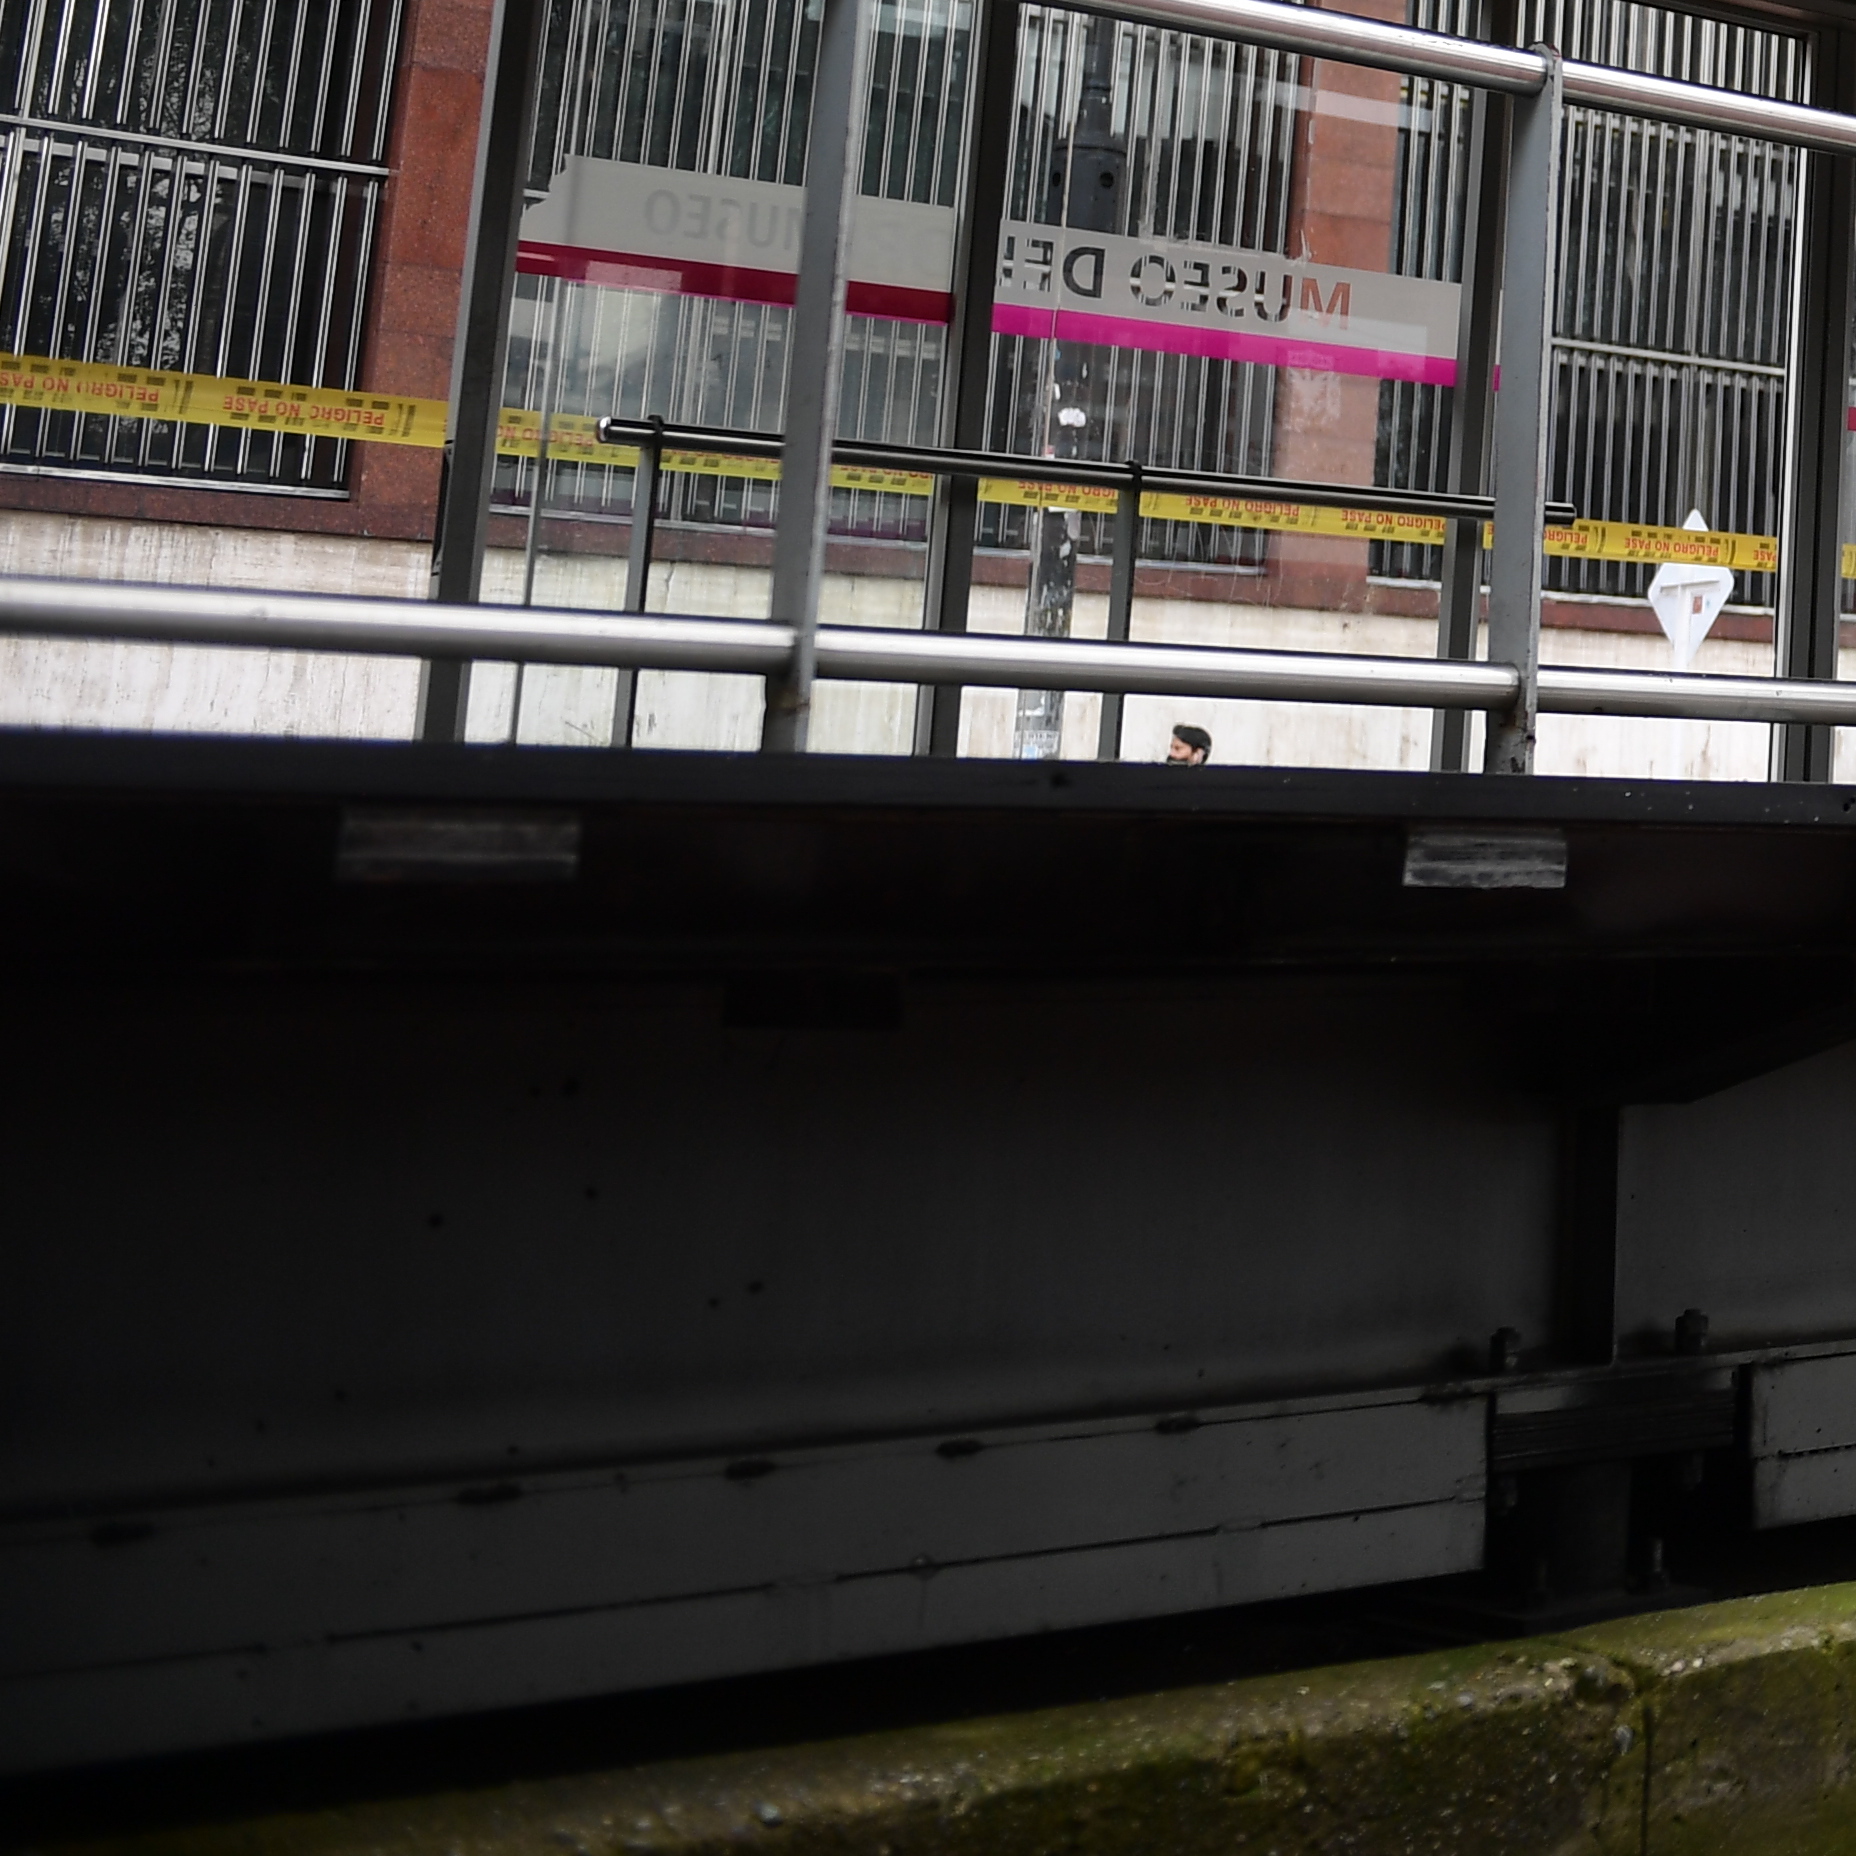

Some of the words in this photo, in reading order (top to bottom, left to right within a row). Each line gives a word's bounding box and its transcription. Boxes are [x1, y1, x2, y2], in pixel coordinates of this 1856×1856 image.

[43, 377, 74, 393] NO
[223, 394, 271, 414] PASE
[274, 400, 301, 417] NO
[1185, 495, 1217, 508] PASE
[1219, 496, 1240, 511] NO
[1244, 500, 1300, 517] PELIGRO
[1341, 509, 1372, 522] PASE
[1375, 513, 1394, 525] NO
[1624, 537, 1651, 550] PASE
[1654, 541, 1670, 552] NO
[1673, 542, 1719, 558] PELIGRO
